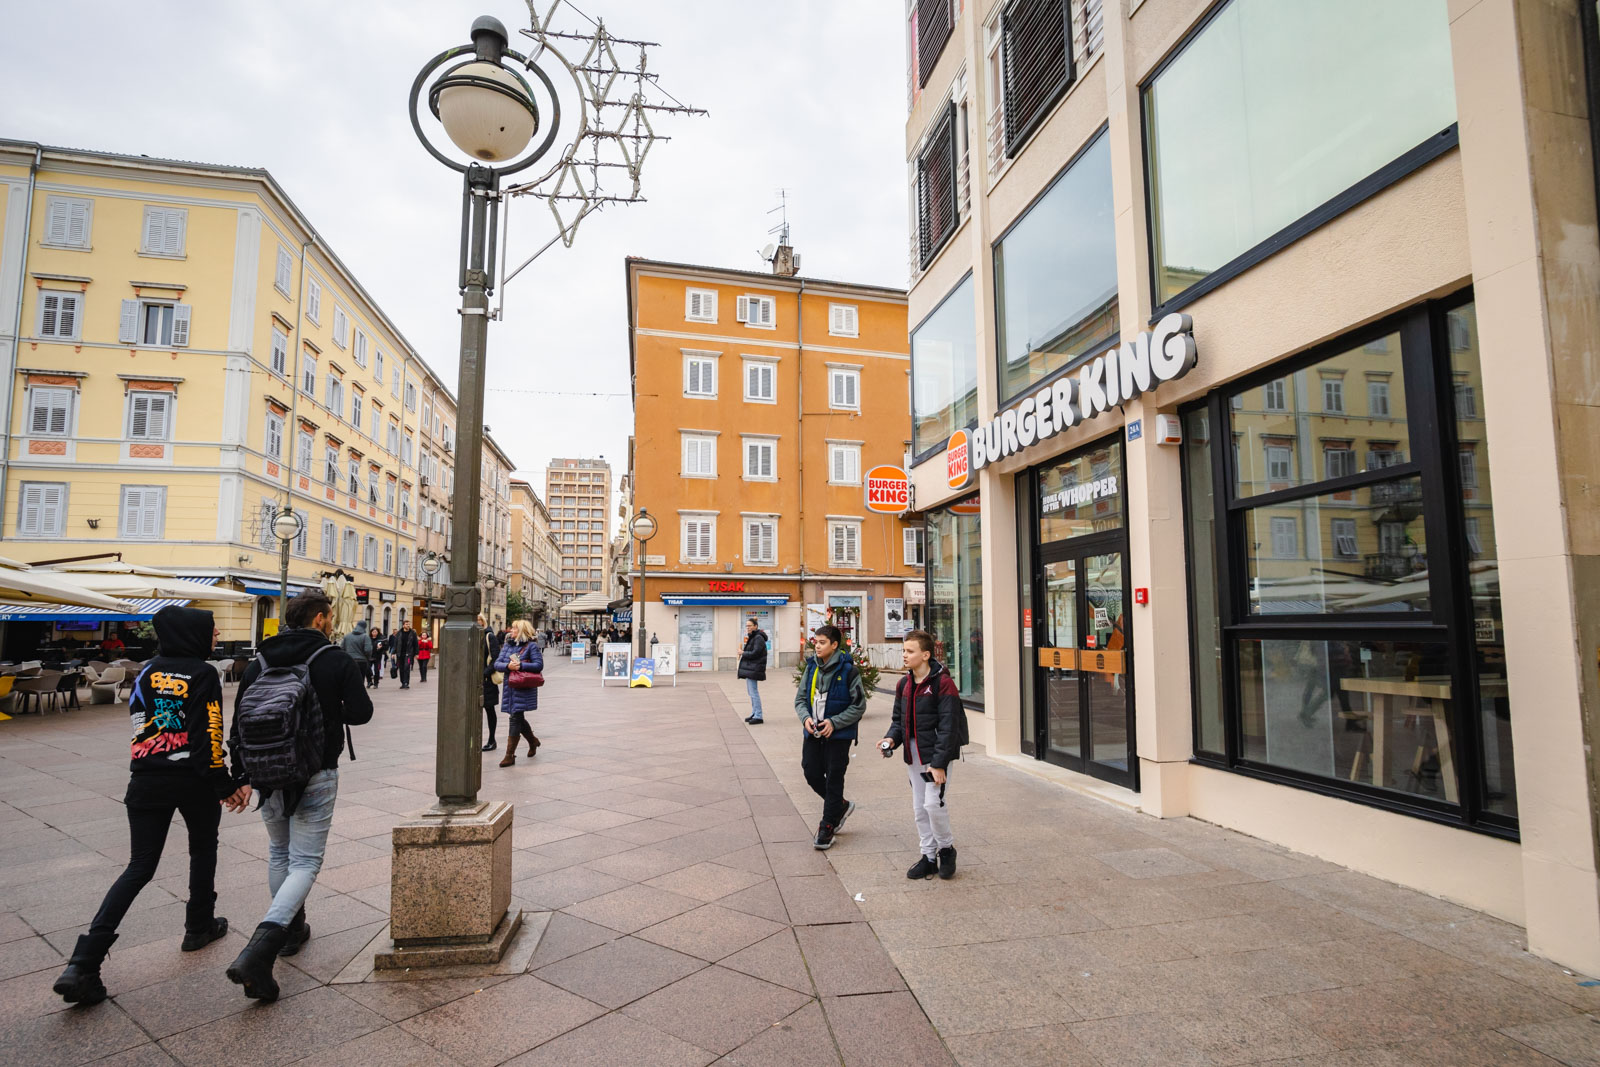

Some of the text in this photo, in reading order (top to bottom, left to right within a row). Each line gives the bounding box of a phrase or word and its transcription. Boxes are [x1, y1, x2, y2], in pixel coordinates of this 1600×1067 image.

[972, 313, 1190, 470] BURGER KING
[1130, 424, 1140, 434] 24A
[947, 445, 967, 463] BURGER
[948, 457, 968, 479] KING
[868, 480, 908, 490] BURGER
[868, 489, 908, 503] KING
[1058, 476, 1118, 508] WHOPPER
[1042, 494, 1058, 505] HOME
[1049, 501, 1060, 511] THE
[708, 581, 745, 592] TISAK
